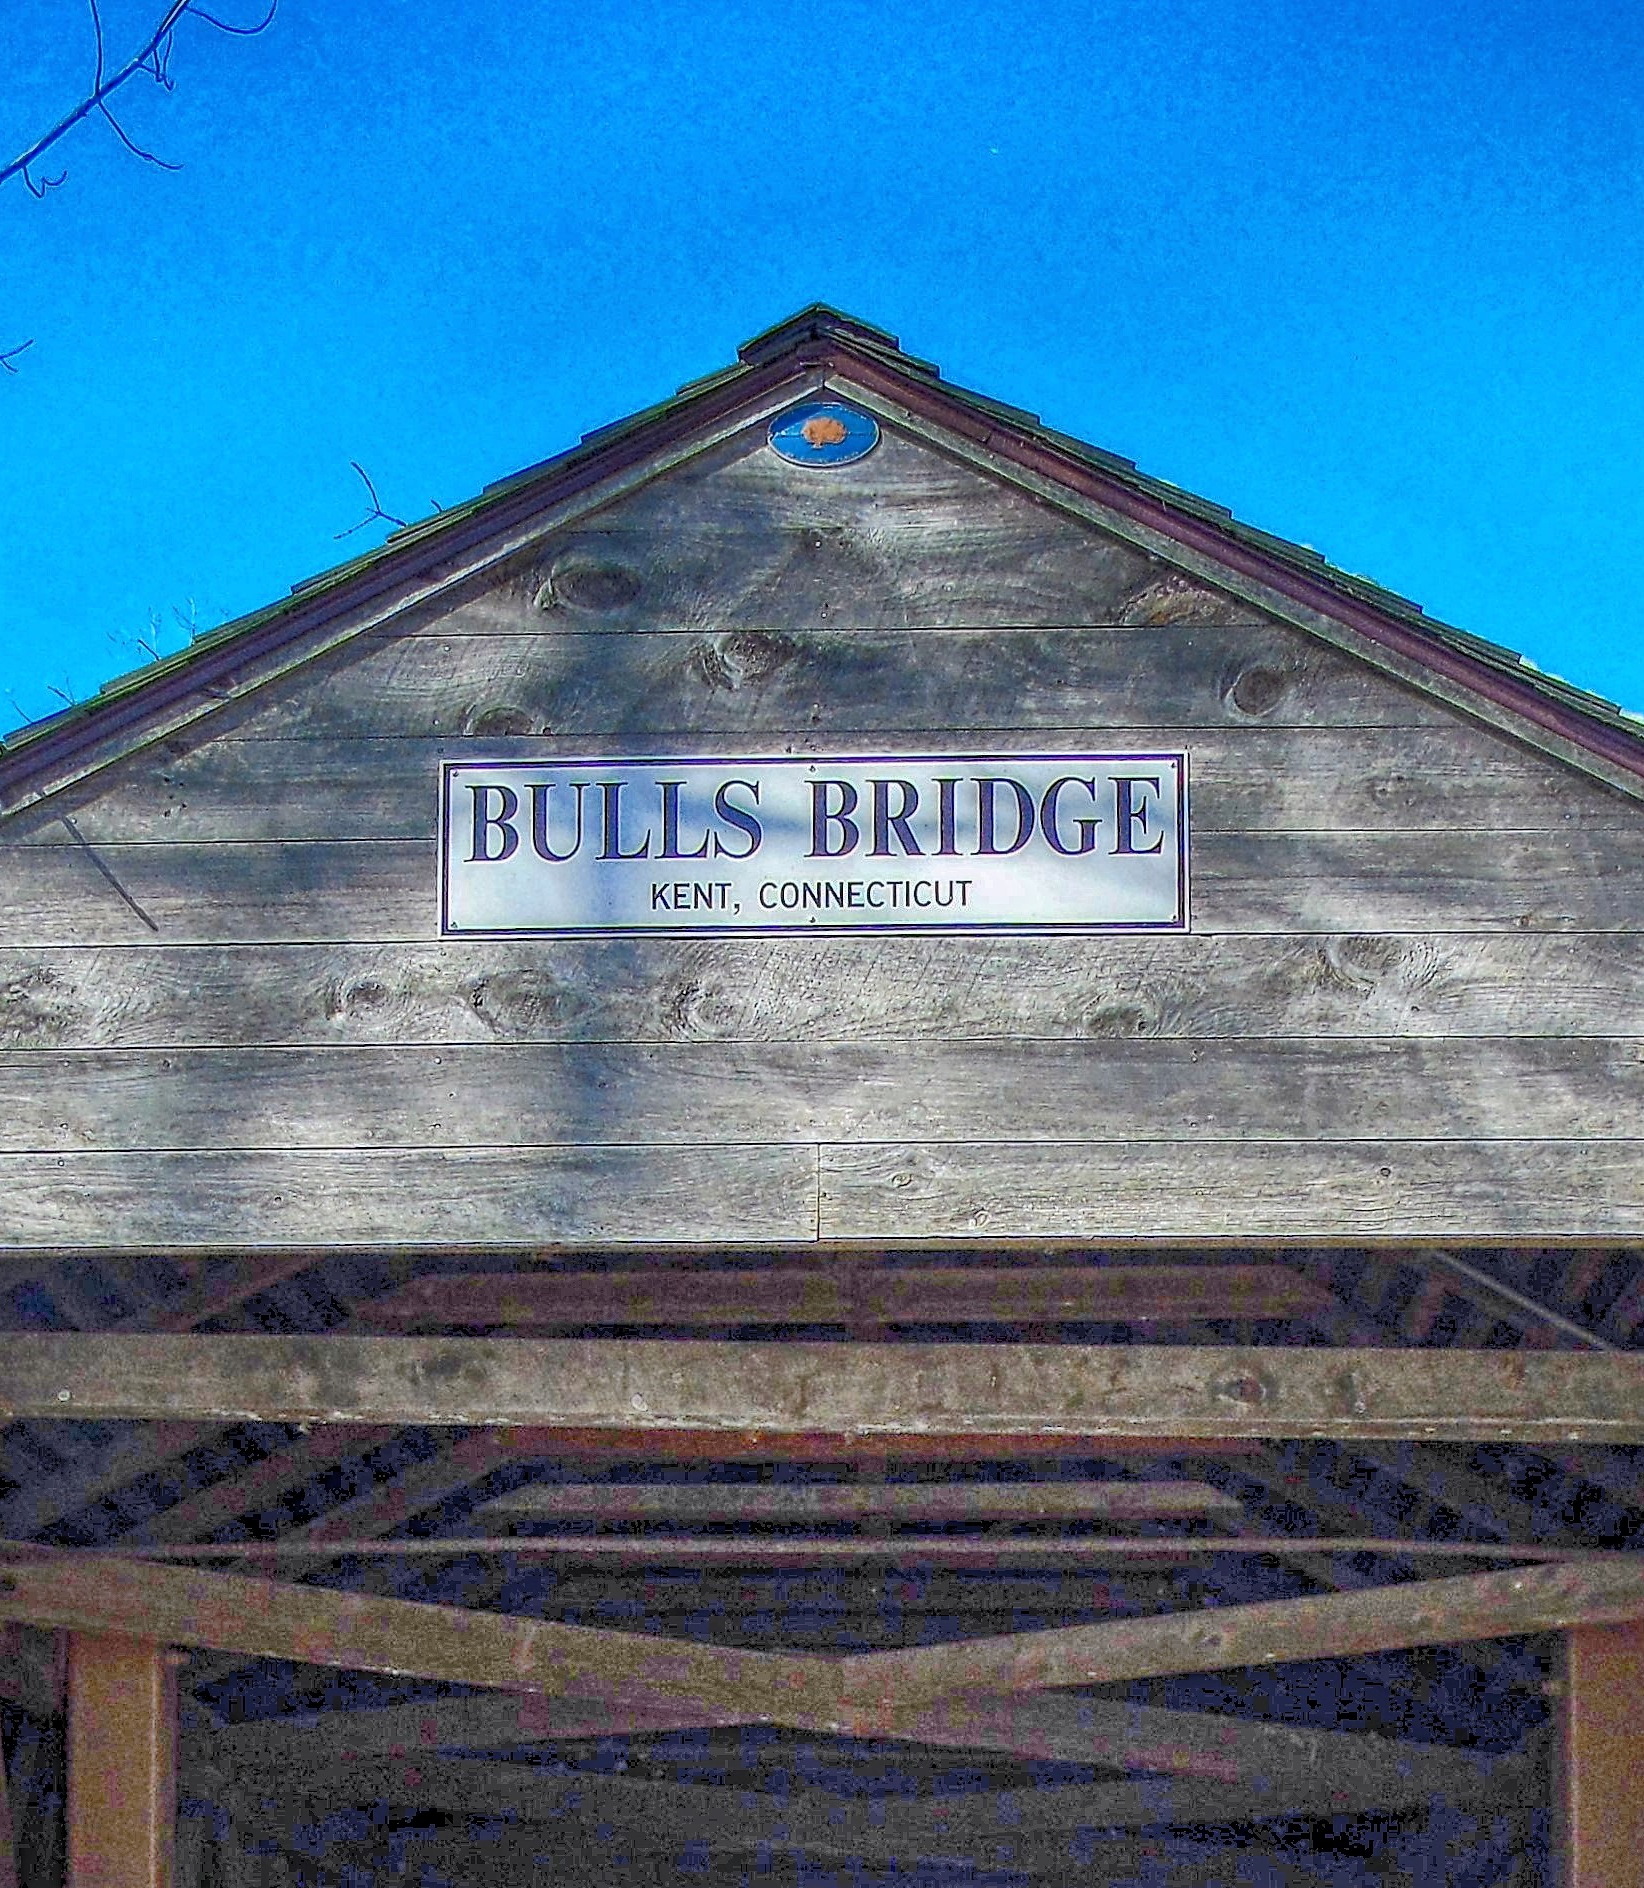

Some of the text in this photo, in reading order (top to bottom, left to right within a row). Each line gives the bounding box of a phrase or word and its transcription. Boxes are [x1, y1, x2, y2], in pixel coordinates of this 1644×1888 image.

[463, 776, 1165, 862] BULLS BRIDGE
[651, 880, 973, 916] KENT, CONNECTICUT
